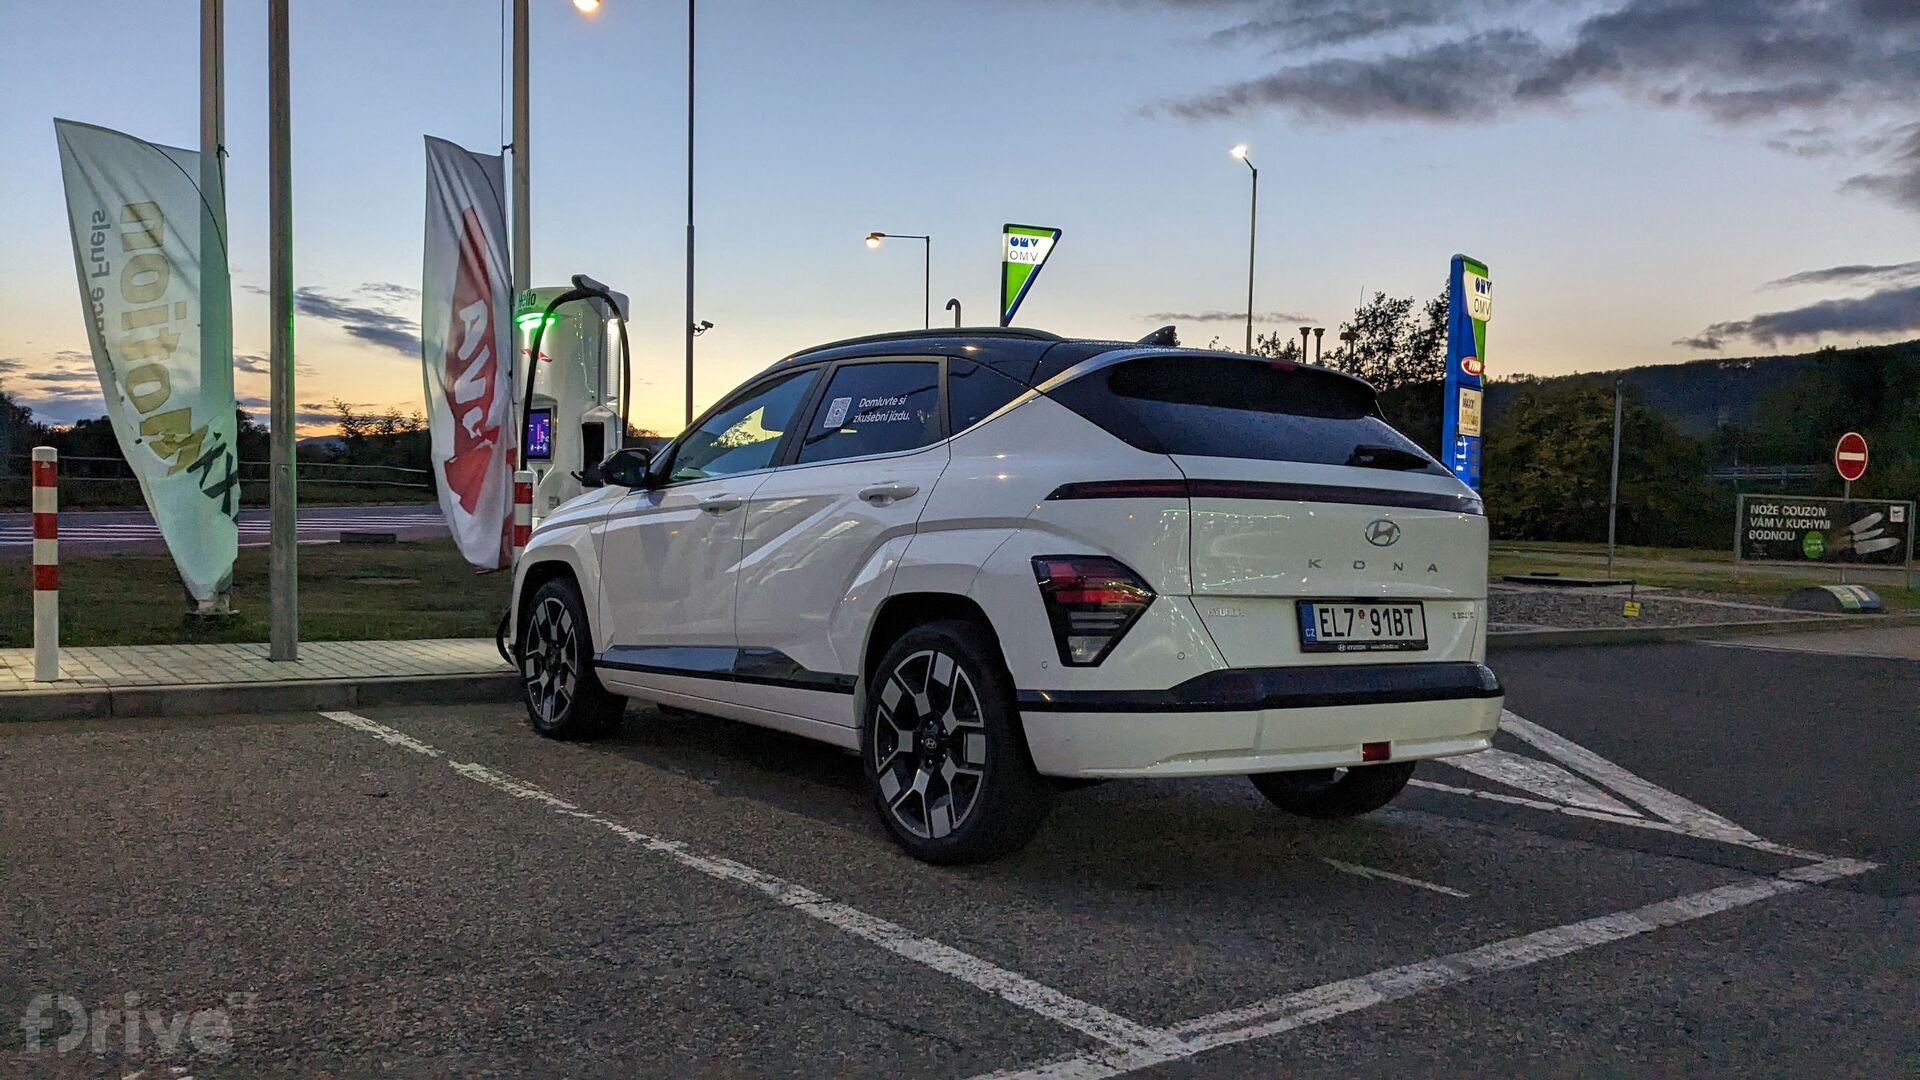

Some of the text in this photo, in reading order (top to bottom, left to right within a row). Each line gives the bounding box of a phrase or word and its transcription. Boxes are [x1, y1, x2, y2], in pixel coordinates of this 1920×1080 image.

[1010, 236, 1039, 247] OMV
[1010, 250, 1038, 261] OMV
[1475, 276, 1492, 294] OMV
[1474, 298, 1490, 316] OMV
[858, 395, 908, 408] Domluvte si
[853, 410, 910, 423] zkušební jízdu.
[1750, 504, 1827, 517] NOŽE COUZON
[1750, 517, 1774, 528] VÁM
[1775, 518, 1784, 528] V
[1307, 558, 1438, 573] KONA
[1320, 607, 1414, 638] EL7 91BT
[1305, 628, 1316, 638] CZ
